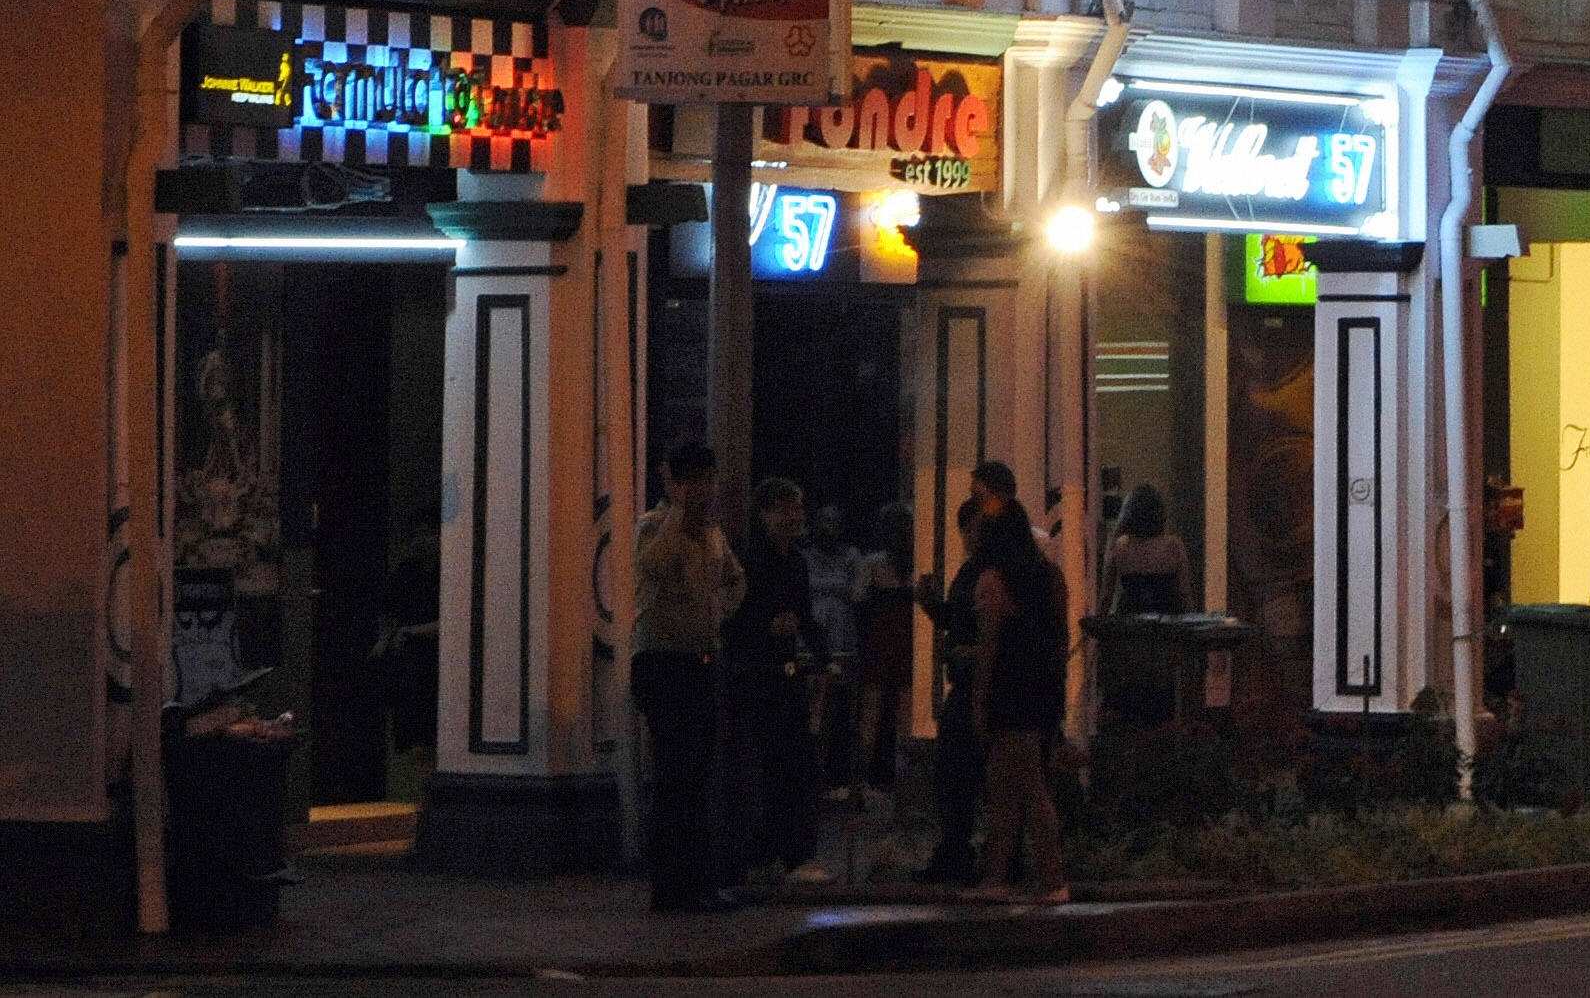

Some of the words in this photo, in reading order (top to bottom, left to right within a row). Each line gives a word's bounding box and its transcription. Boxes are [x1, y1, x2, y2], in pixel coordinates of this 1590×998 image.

[632, 70, 712, 87] TANJONG
[715, 70, 775, 87] PAGAR
[905, 161, 931, 184] est
[934, 160, 972, 189] 1999
[1331, 132, 1376, 205] 57
[781, 195, 837, 271] 57
